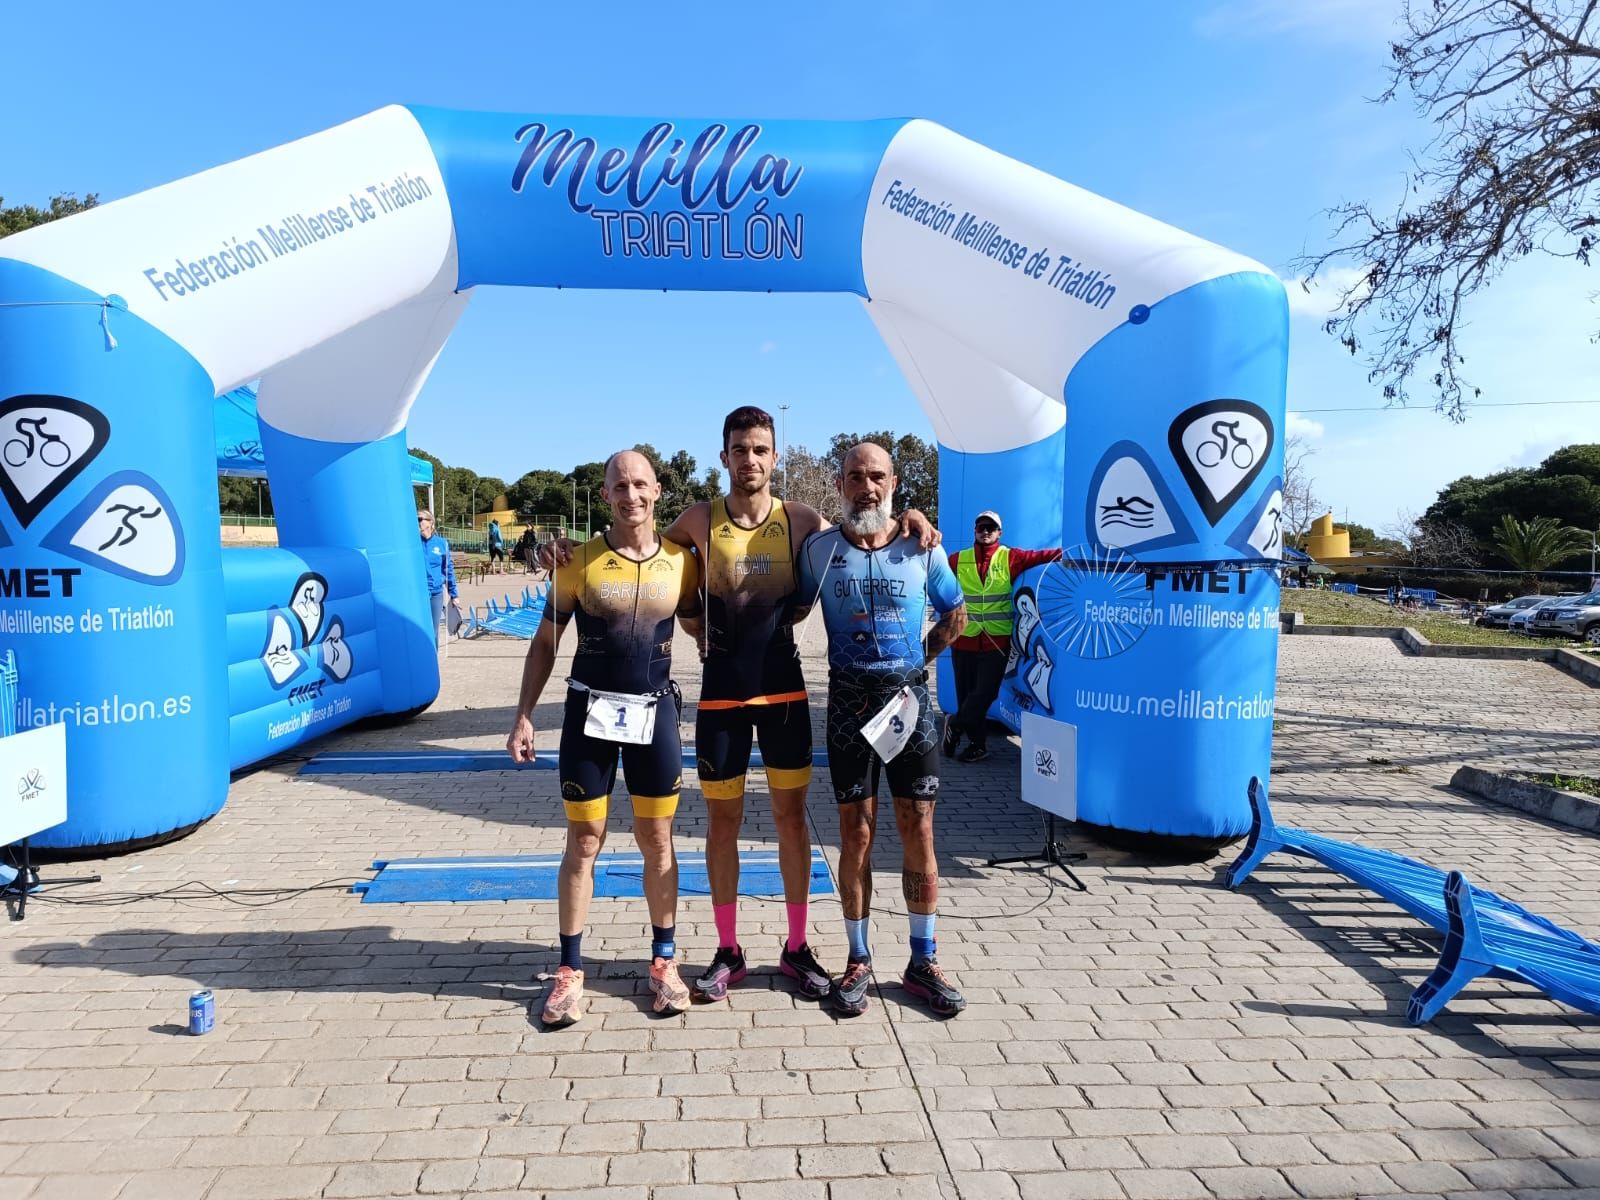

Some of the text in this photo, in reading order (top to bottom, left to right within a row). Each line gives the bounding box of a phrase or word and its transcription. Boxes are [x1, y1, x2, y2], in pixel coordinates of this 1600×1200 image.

[511, 122, 803, 212] Melilla
[144, 172, 432, 301] Federación Melillense de Triatlón
[591, 198, 804, 260] TRIATLÓN
[882, 180, 1117, 309] Federación Melillense de Triatlón
[600, 581, 669, 600] BARRIOS
[1145, 569, 1253, 595] FMET
[0, 604, 174, 635] Melillense de Triatlón
[1084, 599, 1164, 626] Federación
[1169, 603, 1245, 630] Melillense
[1247, 607, 1261, 630] de
[288, 679, 326, 706] FMET
[15, 694, 192, 727] illatriatlon.es
[614, 706, 628, 728] 1
[889, 714, 905, 734] 3
